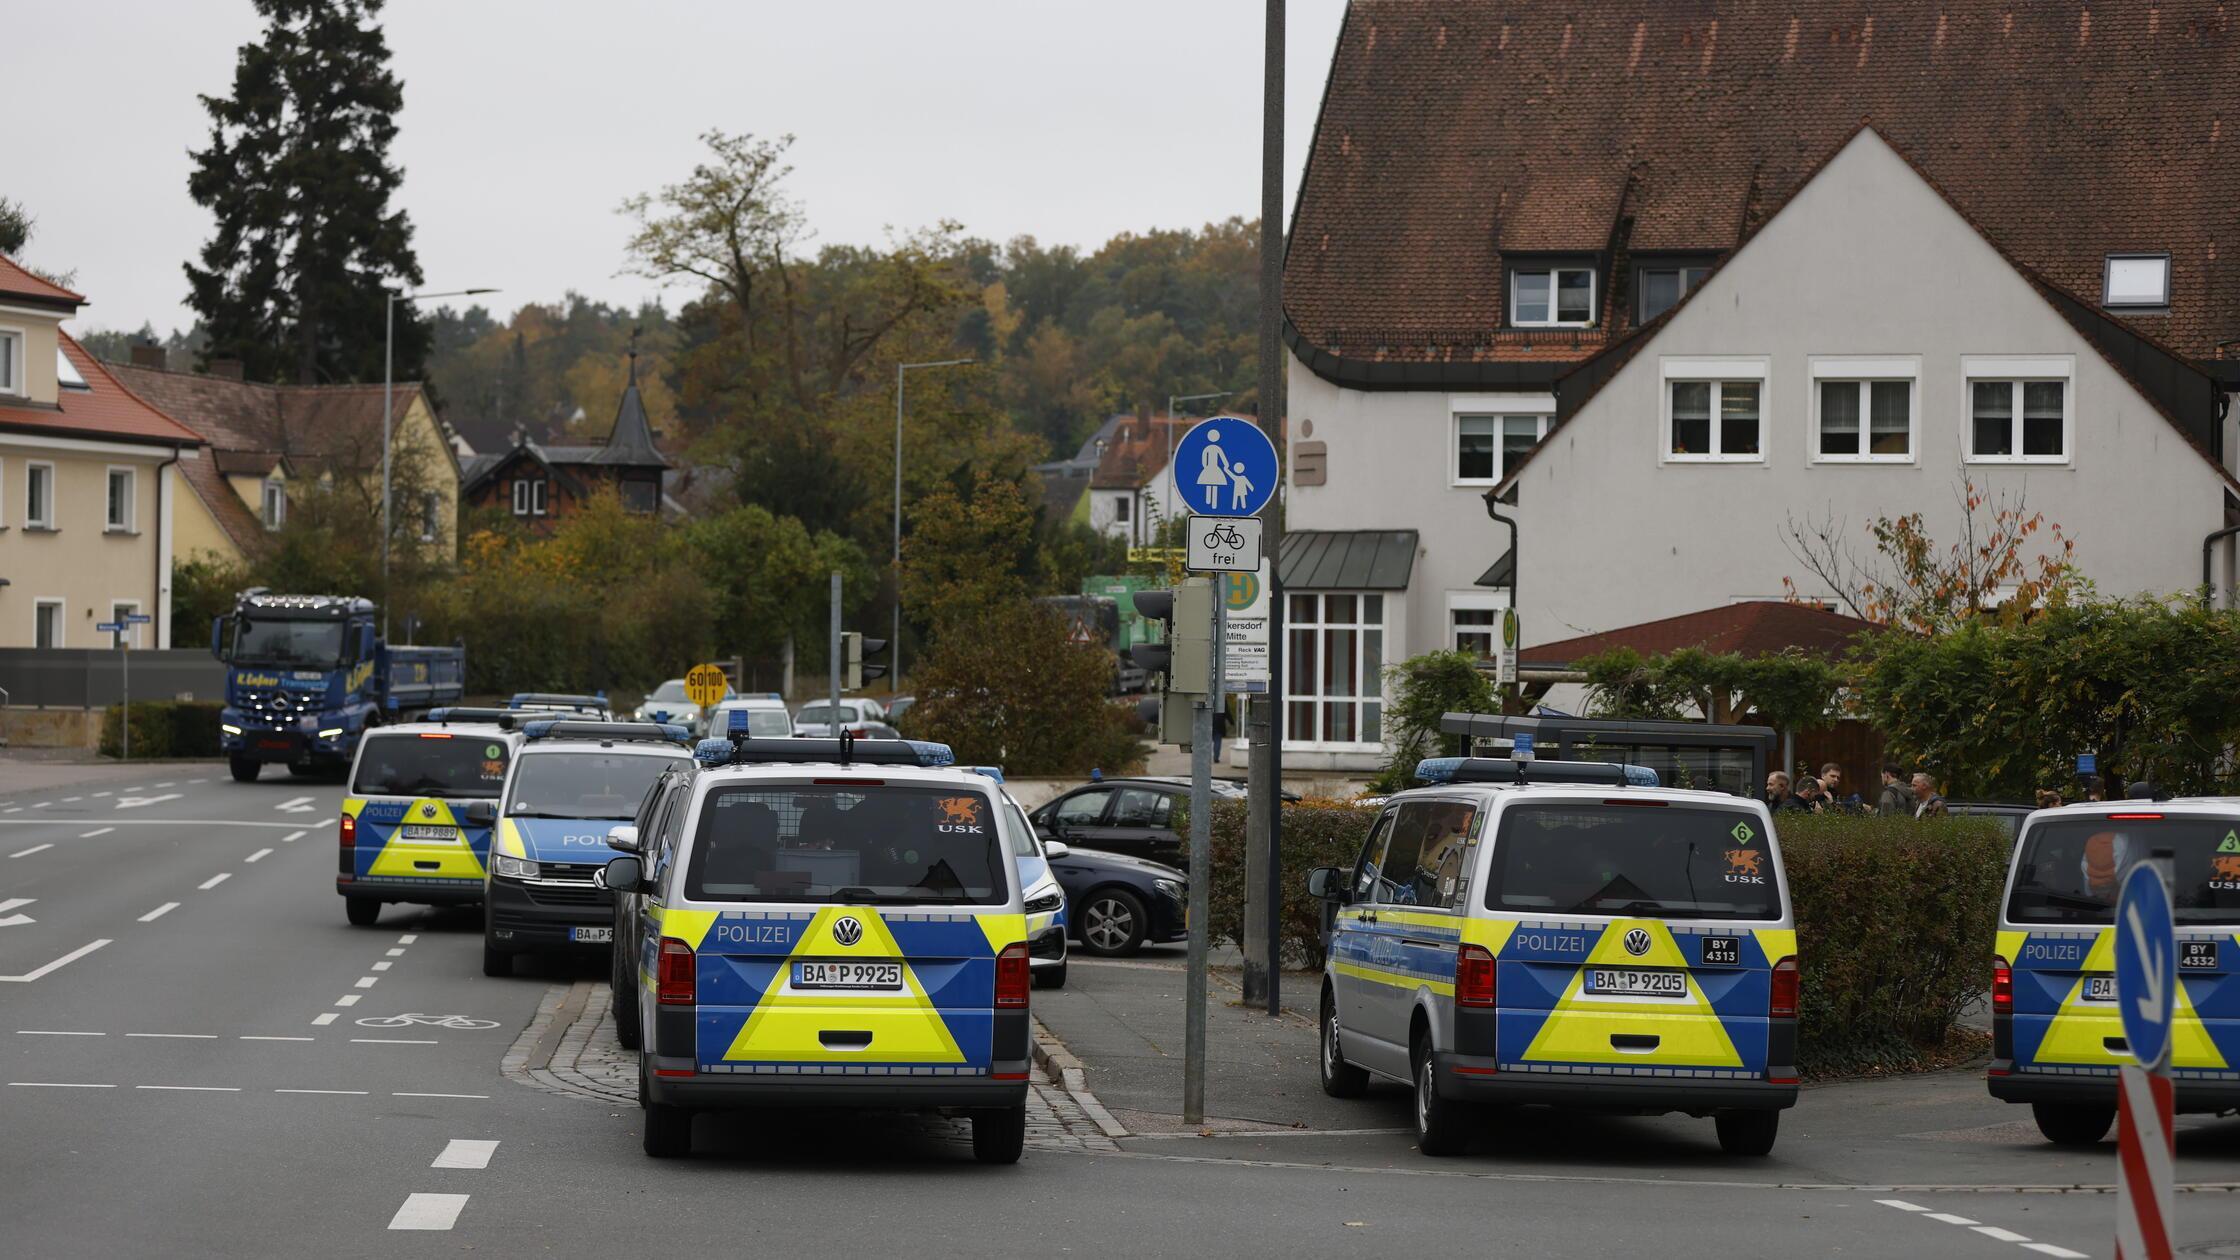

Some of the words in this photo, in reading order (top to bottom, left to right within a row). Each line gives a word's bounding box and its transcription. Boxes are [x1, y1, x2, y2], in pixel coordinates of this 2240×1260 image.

[1212, 553, 1235, 564] frei
[1227, 622, 1262, 630] kersdorf
[1226, 632, 1247, 641] Mitte
[689, 672, 704, 687] 60
[708, 672, 723, 687] 100
[365, 806, 402, 818] POLIZEI
[407, 825, 420, 837] BA
[425, 826, 432, 837] P
[433, 827, 456, 838] 9889
[937, 824, 984, 834] USK
[1737, 825, 1748, 841] 6
[563, 834, 609, 847] POL
[2225, 836, 2236, 851] 3
[1724, 874, 1766, 885] USK
[576, 928, 592, 940] BA
[598, 929, 606, 940] P
[717, 925, 791, 943] POLIZEI
[1516, 934, 1585, 953] POLIZEI
[1712, 940, 1728, 949] BY
[2025, 944, 2081, 961] POLIZEI
[2190, 945, 2207, 955] BY
[1706, 951, 1736, 962] 4313
[2182, 956, 2216, 966] 4332
[803, 964, 827, 983] BA
[839, 965, 850, 983] P
[853, 966, 899, 983] 9925
[1595, 971, 1618, 989] BA
[1628, 973, 1639, 990] P
[1641, 974, 1683, 991] 9205
[2091, 979, 2111, 995] BA
